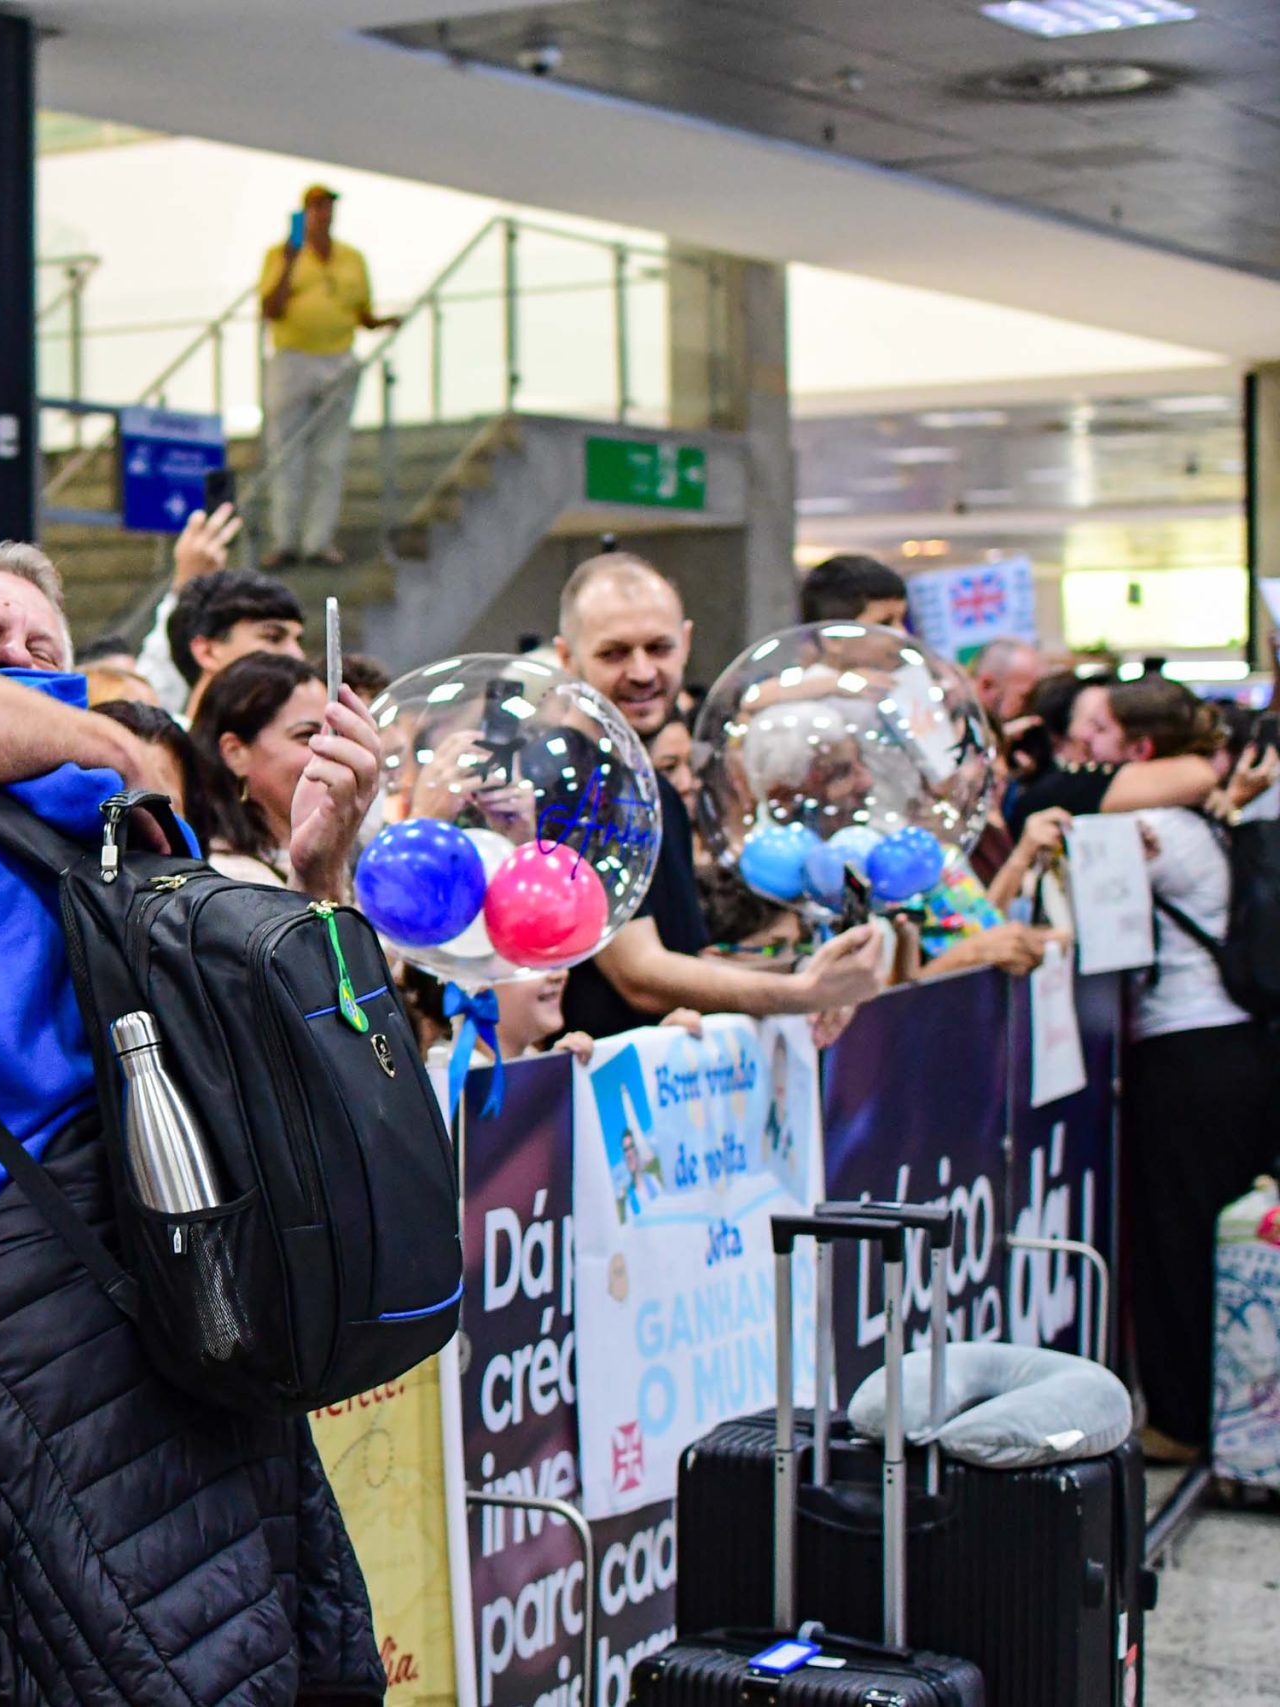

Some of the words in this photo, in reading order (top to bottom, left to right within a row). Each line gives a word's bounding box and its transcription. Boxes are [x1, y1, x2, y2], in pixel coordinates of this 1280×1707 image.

[484, 1188, 554, 1312] Dá
[638, 1365, 677, 1437] O
[482, 1450, 577, 1557] inve
